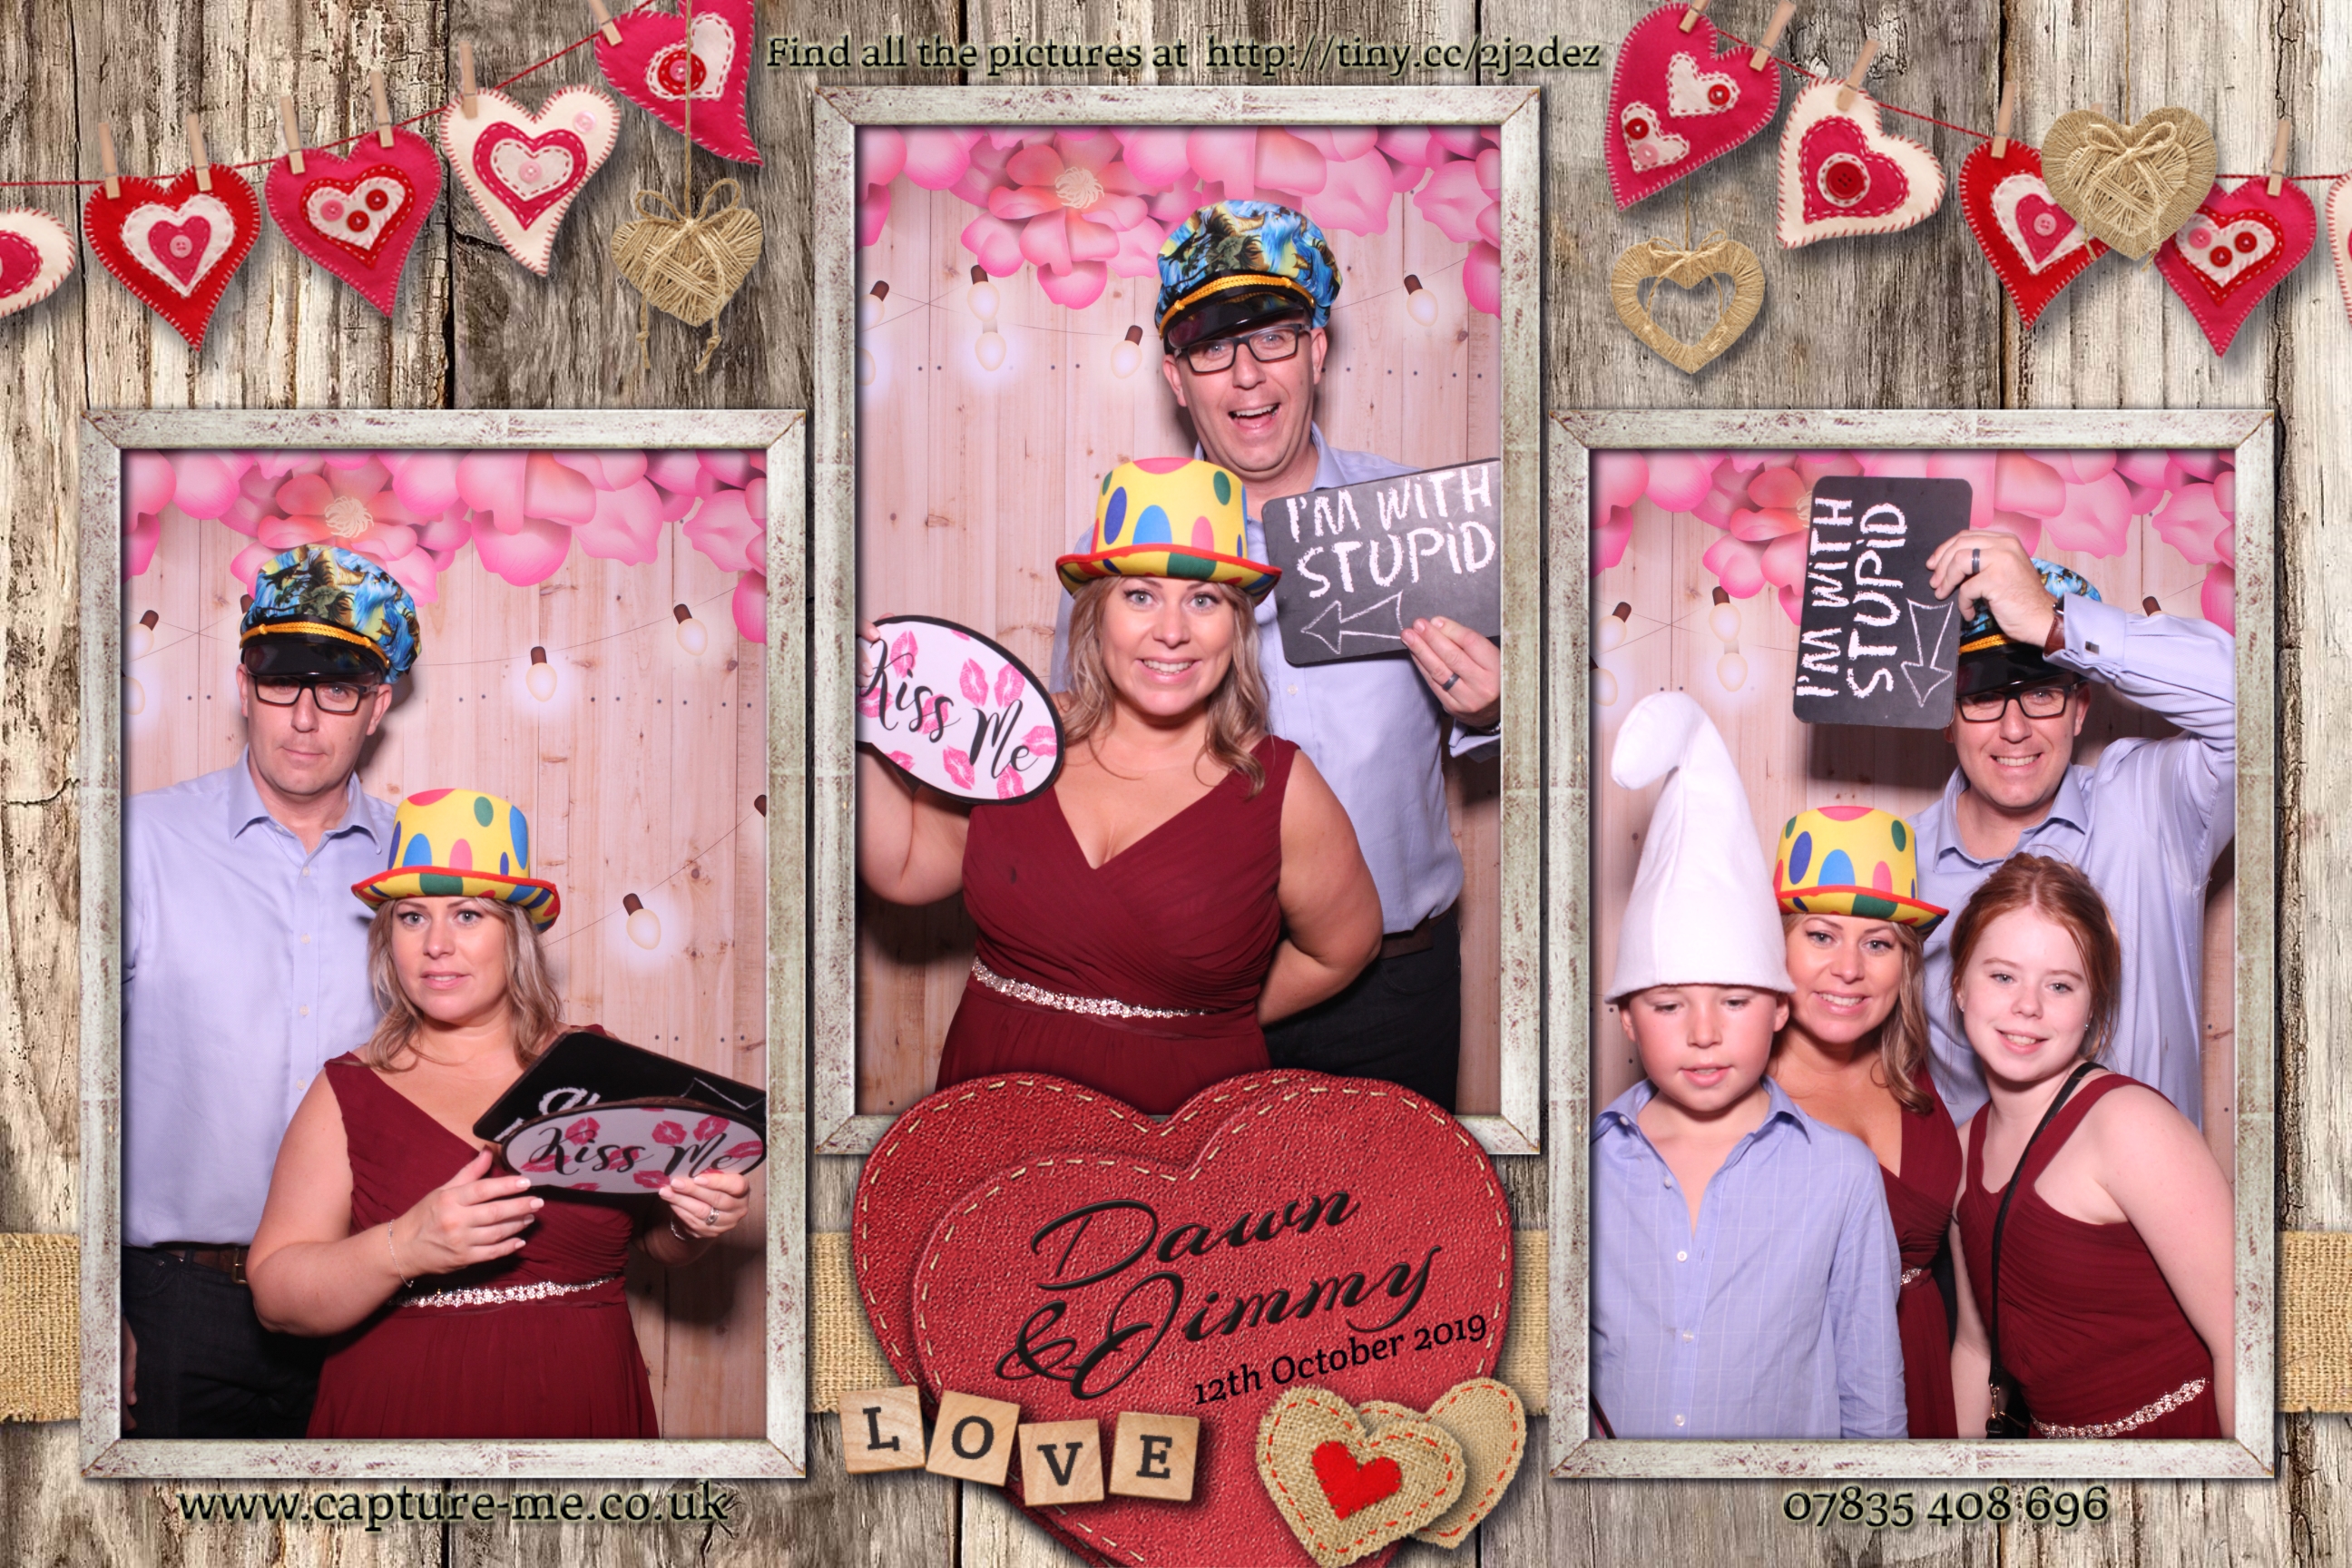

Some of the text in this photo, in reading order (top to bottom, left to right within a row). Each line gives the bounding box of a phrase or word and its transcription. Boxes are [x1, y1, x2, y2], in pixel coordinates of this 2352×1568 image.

[1286, 489, 1361, 543] I'M
[1796, 627, 1843, 697] I'M
[859, 638, 1039, 779] Kiss Me
[528, 1126, 654, 1176] Kiss
[664, 1132, 742, 1179] Me
